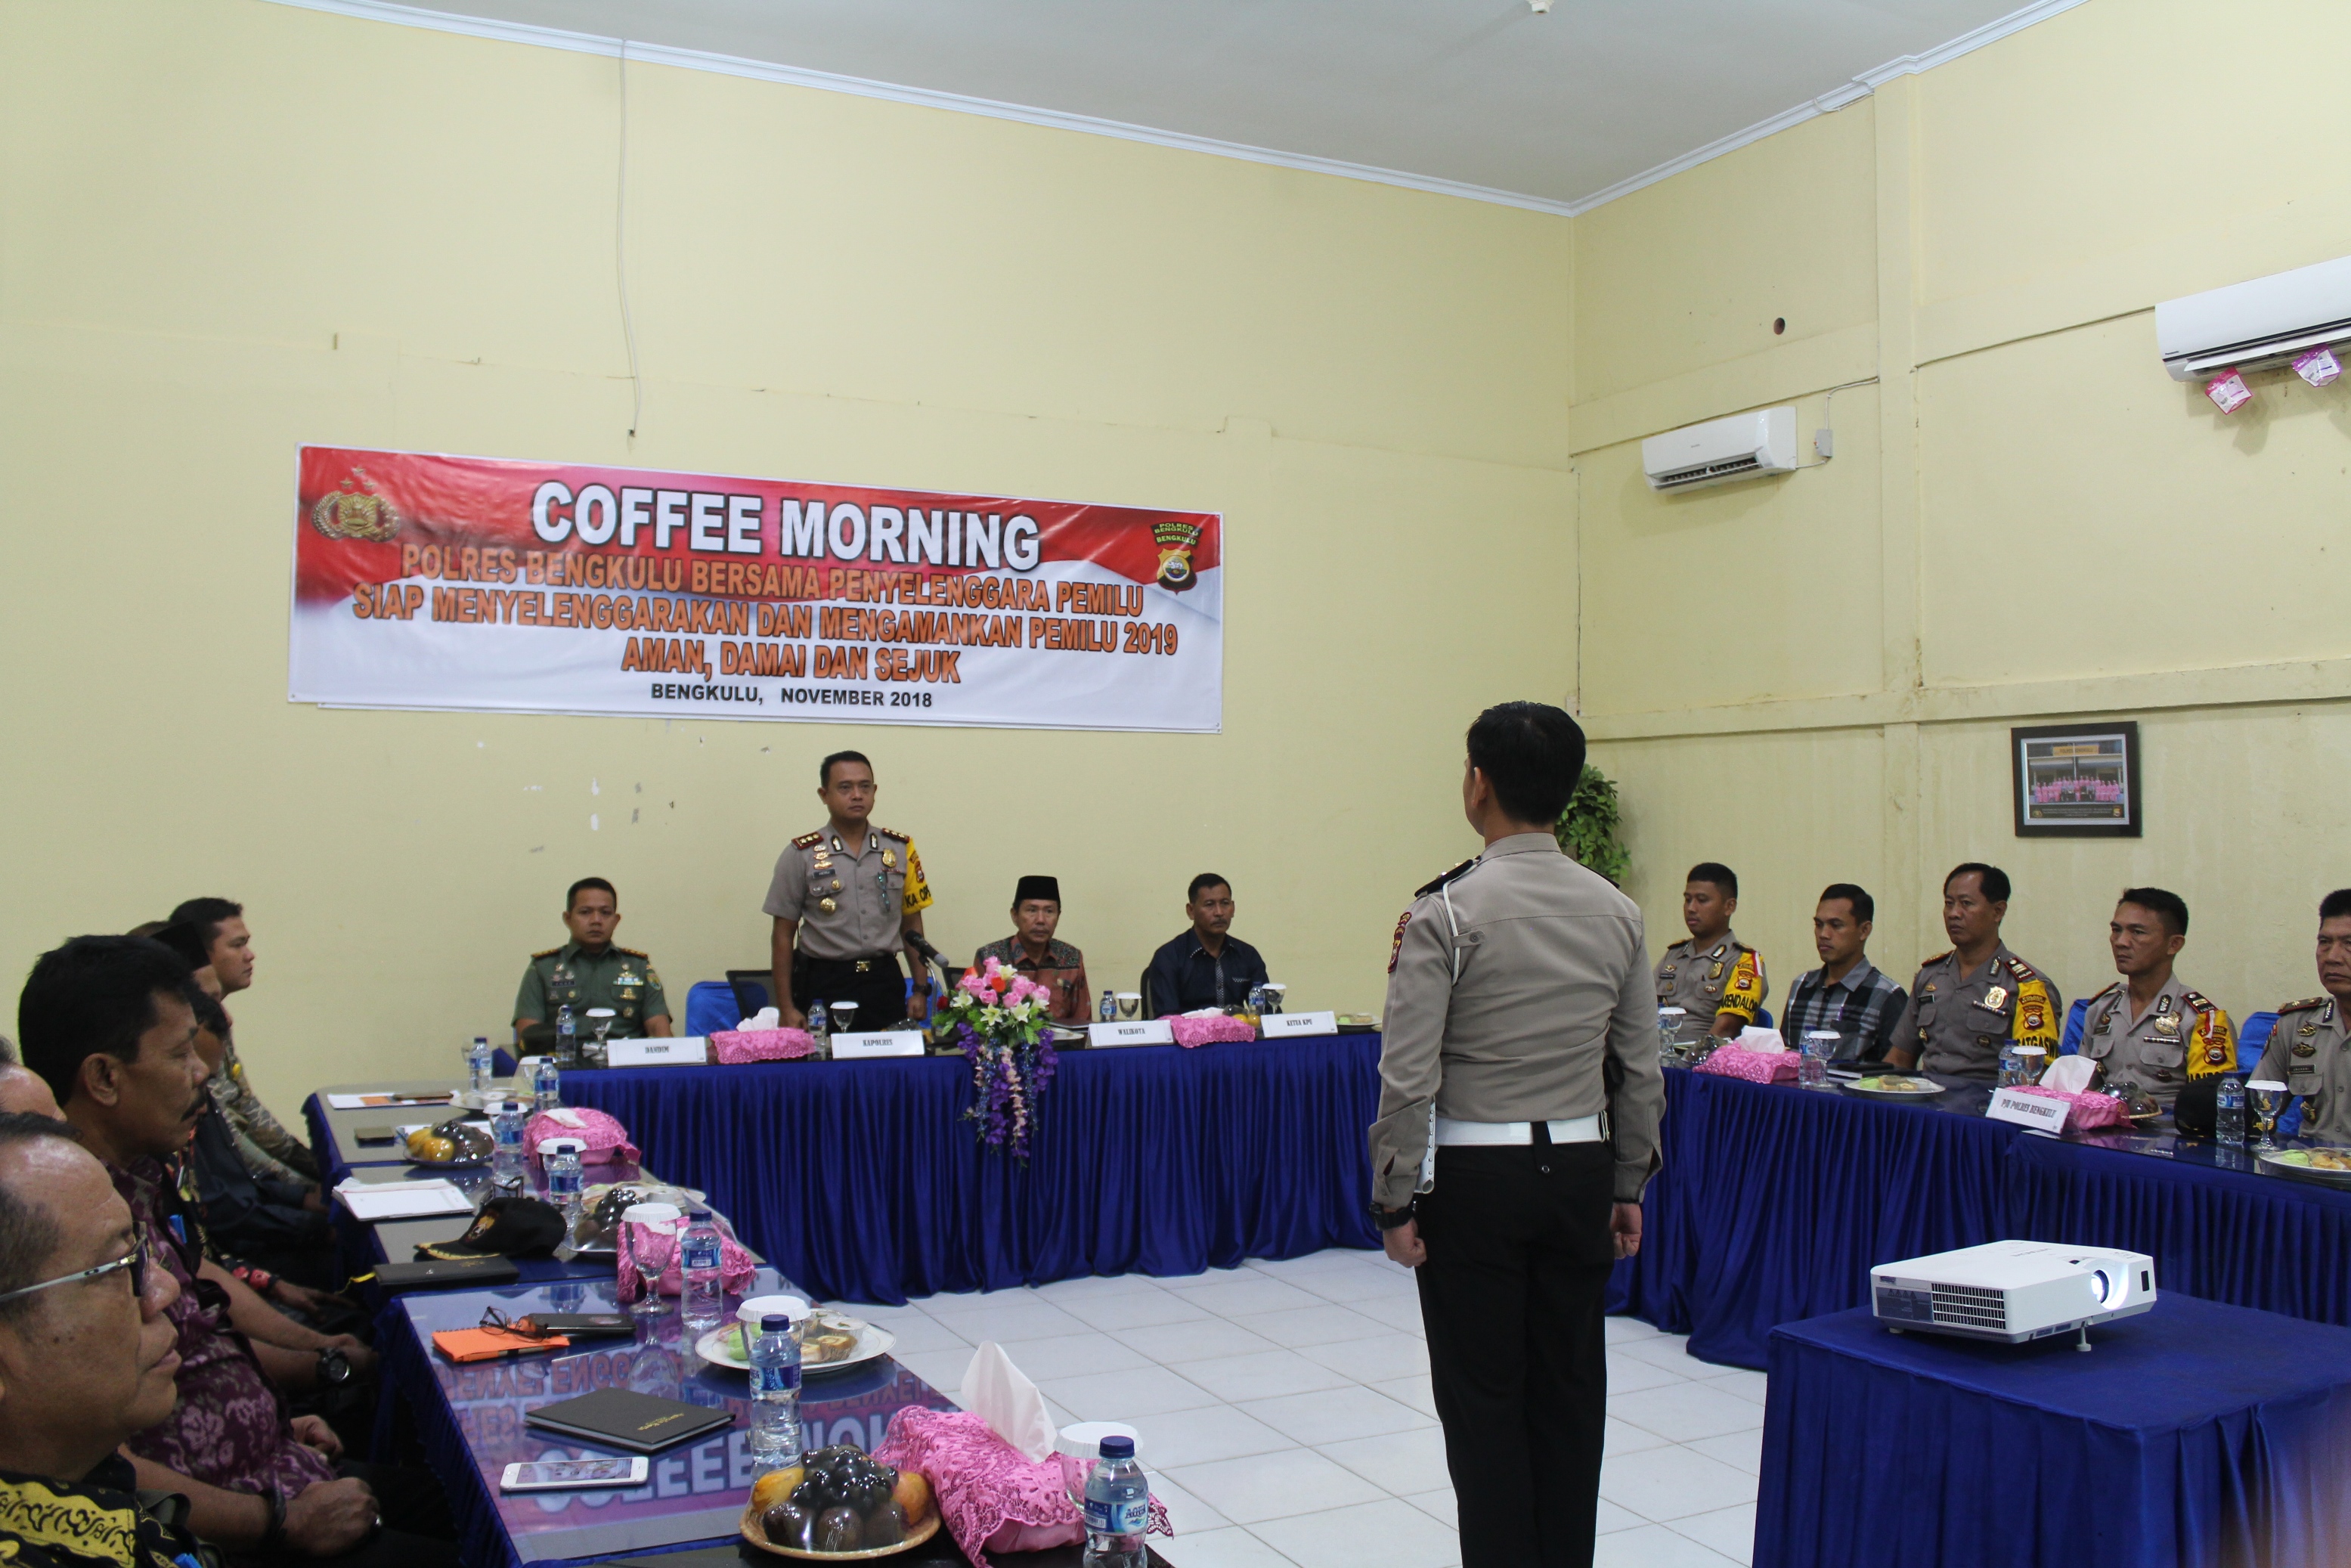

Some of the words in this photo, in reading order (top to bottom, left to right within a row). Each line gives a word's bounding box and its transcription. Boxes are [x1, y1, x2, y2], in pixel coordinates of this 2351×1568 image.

[532, 481, 762, 553] COFFEE
[781, 499, 1039, 571] MORNING
[1159, 522, 1194, 531] POLRES
[1156, 535, 1197, 545] BENGKULU
[401, 544, 517, 584] POLRES
[528, 550, 682, 591] BENGKULU
[691, 559, 821, 599] BERSAMA
[829, 569, 1049, 612] PENYELENGGARA
[1057, 581, 1144, 616] PEMILU
[352, 583, 423, 620] SIAP
[432, 587, 748, 635] MENYELENGGARAKAN
[757, 604, 812, 638] DAN
[819, 606, 1022, 646] MENGAMANKAN
[1029, 617, 1118, 652] PEMILU
[1123, 621, 1178, 655] 2019
[620, 637, 712, 681] AMAN,
[720, 642, 806, 677] DAMAI
[813, 645, 867, 680] DAN
[874, 648, 961, 683] SEJUK
[651, 683, 763, 705] BENGKULU,
[781, 688, 884, 706] NOVEMBER
[891, 692, 932, 708] 2018
[905, 893, 918, 907] KA
[645, 1046, 670, 1055] DANDIM
[863, 1039, 893, 1047] KAPOLRES
[2009, 1101, 2030, 1112] POLRES
[2028, 1105, 2057, 1118] BENGKULU
